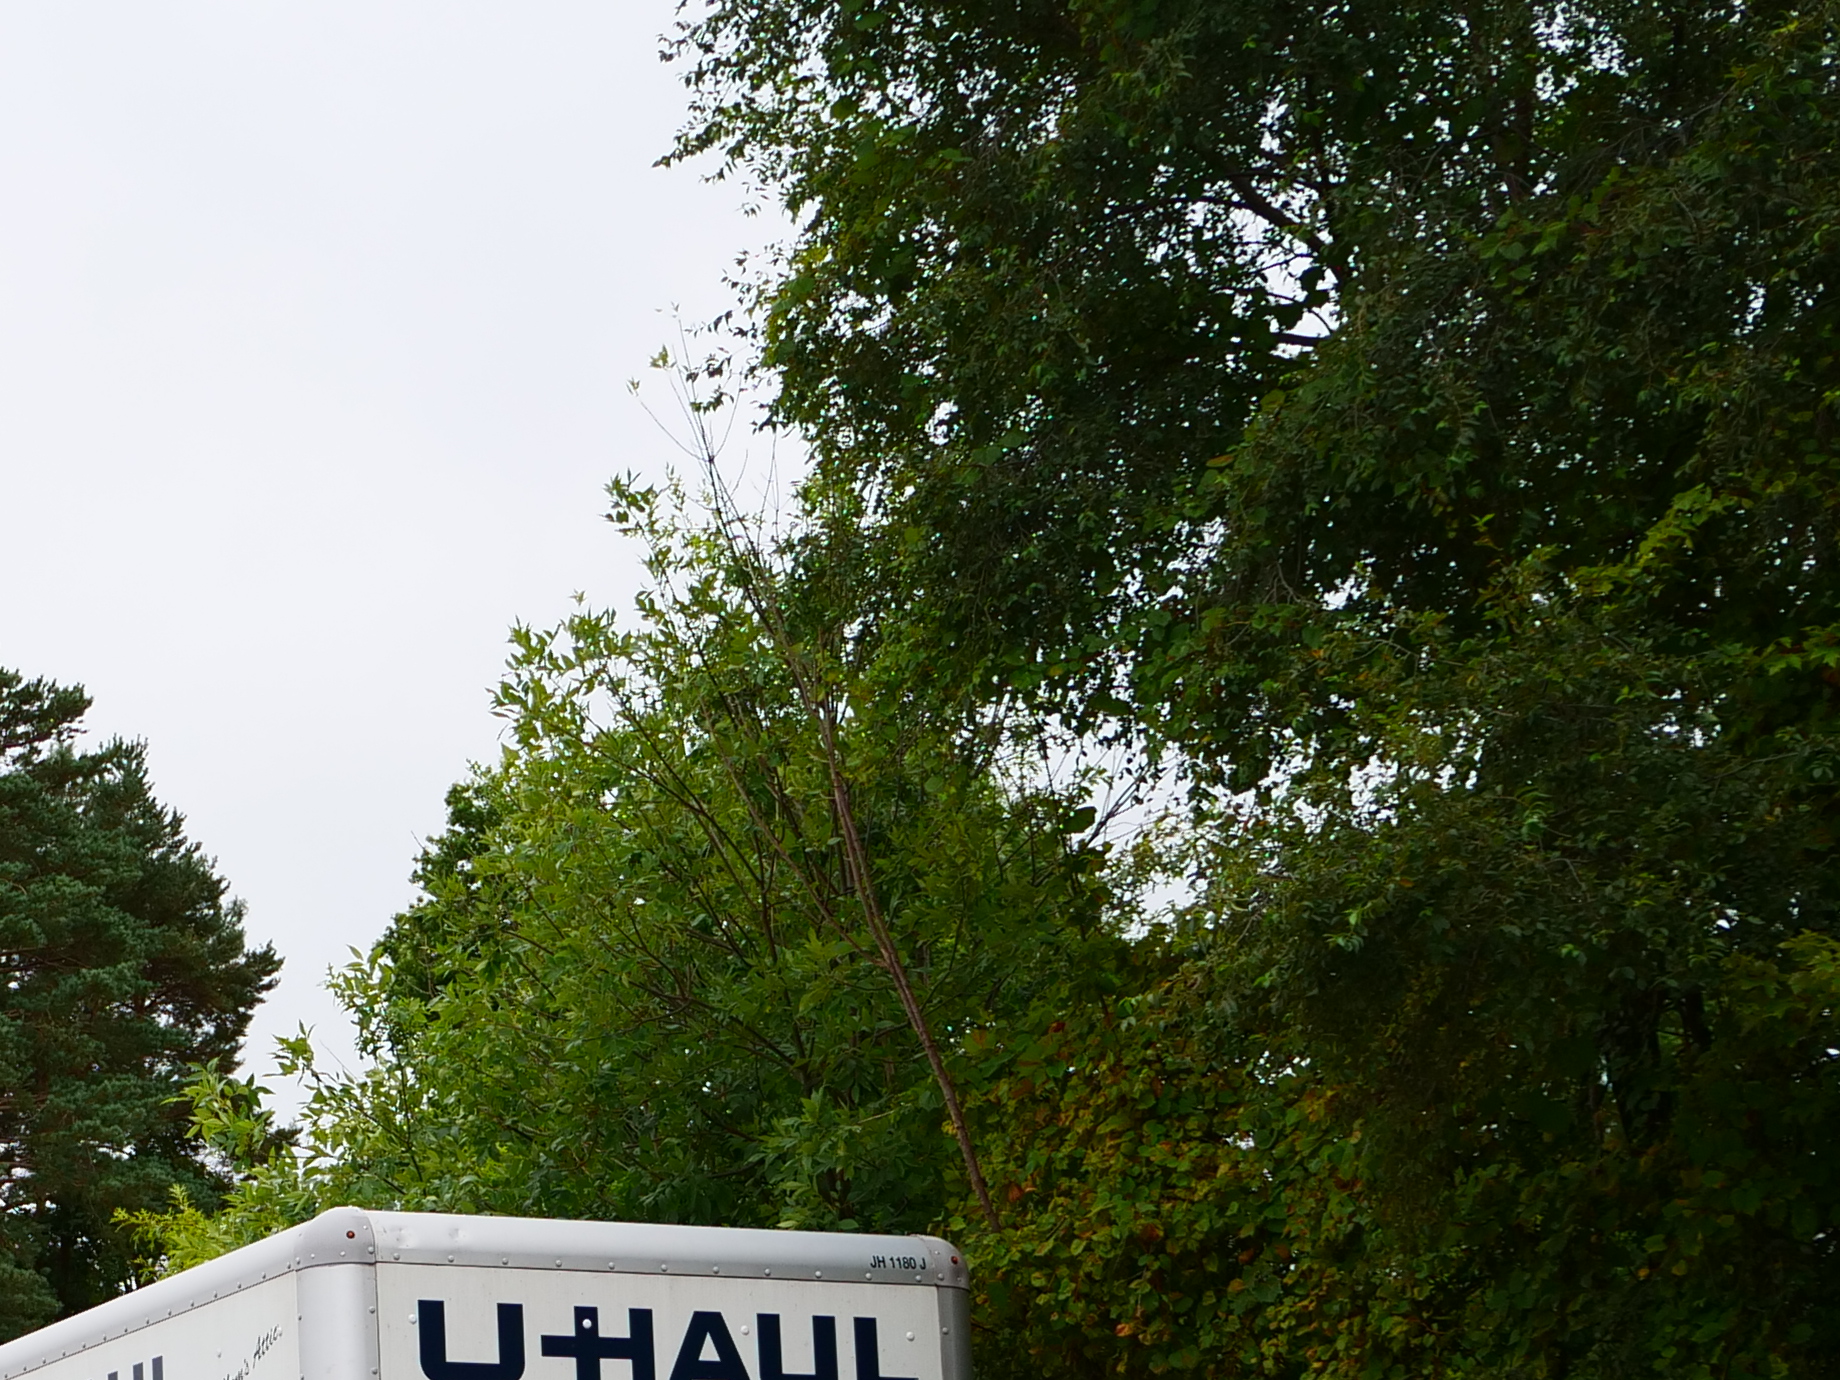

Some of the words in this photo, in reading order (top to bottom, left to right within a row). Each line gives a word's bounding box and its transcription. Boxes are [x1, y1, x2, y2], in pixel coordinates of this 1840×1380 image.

[870, 1255, 886, 1269] JH
[889, 1256, 917, 1270] 1180
[920, 1257, 926, 1270] J
